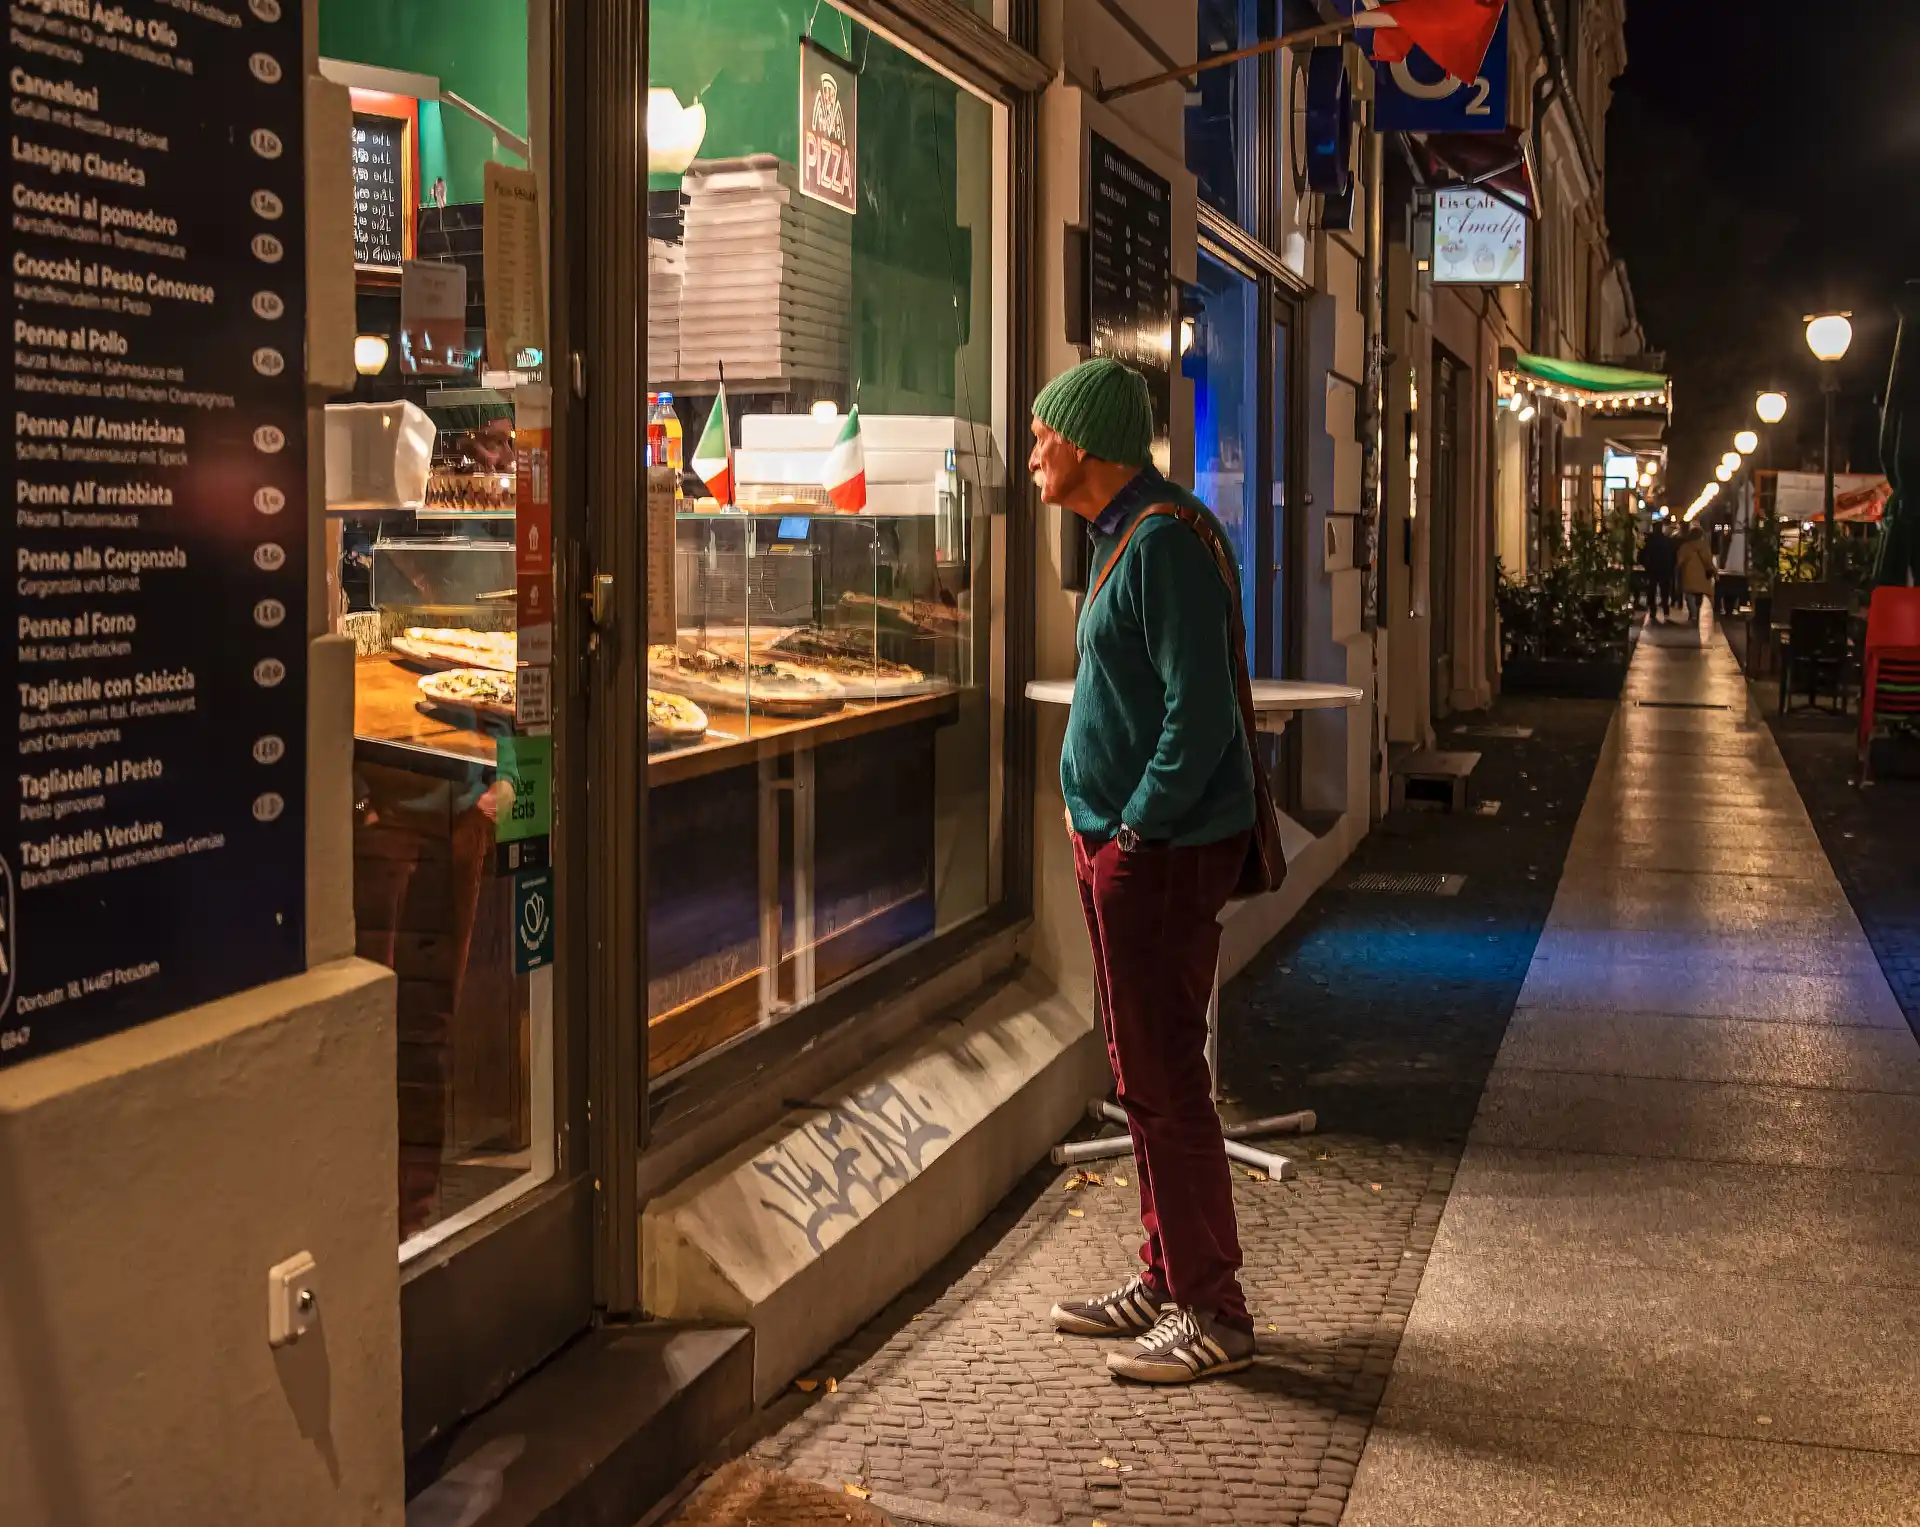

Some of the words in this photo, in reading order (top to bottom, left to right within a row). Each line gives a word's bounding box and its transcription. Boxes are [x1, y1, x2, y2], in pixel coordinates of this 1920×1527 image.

[147, 19, 178, 48] Olio
[10, 66, 99, 111] Cannelloni
[12, 135, 82, 174] Lasagne
[84, 153, 146, 187] Classica
[806, 131, 853, 199] PIZZA
[12, 183, 80, 218] Gnocchi
[83, 196, 98, 220] al
[101, 205, 178, 236] pomodoro
[1438, 210, 1522, 243] Amalfi
[13, 251, 81, 284] Gnocchi
[84, 262, 99, 287] al
[101, 265, 144, 293] Pesto
[146, 272, 215, 305] Genovese
[14, 319, 68, 349] Penne
[70, 324, 86, 350] al
[88, 328, 128, 356] Pollo
[15, 411, 69, 438] Penne
[16, 479, 70, 505] Penne
[17, 547, 70, 572] Penne
[73, 545, 101, 571] alla
[104, 545, 188, 574] Gorgonzola
[18, 614, 71, 640] Penne
[73, 611, 90, 637] al
[91, 611, 137, 635] Forno
[18, 676, 102, 711] Tagliatelle
[103, 677, 132, 699] con
[134, 666, 196, 696] Salsiccia
[18, 763, 103, 800] Tagliatelle
[104, 761, 120, 785] al
[121, 757, 163, 783] Pesto
[20, 829, 103, 868] Tagliatelle
[104, 820, 164, 849] Verdure
